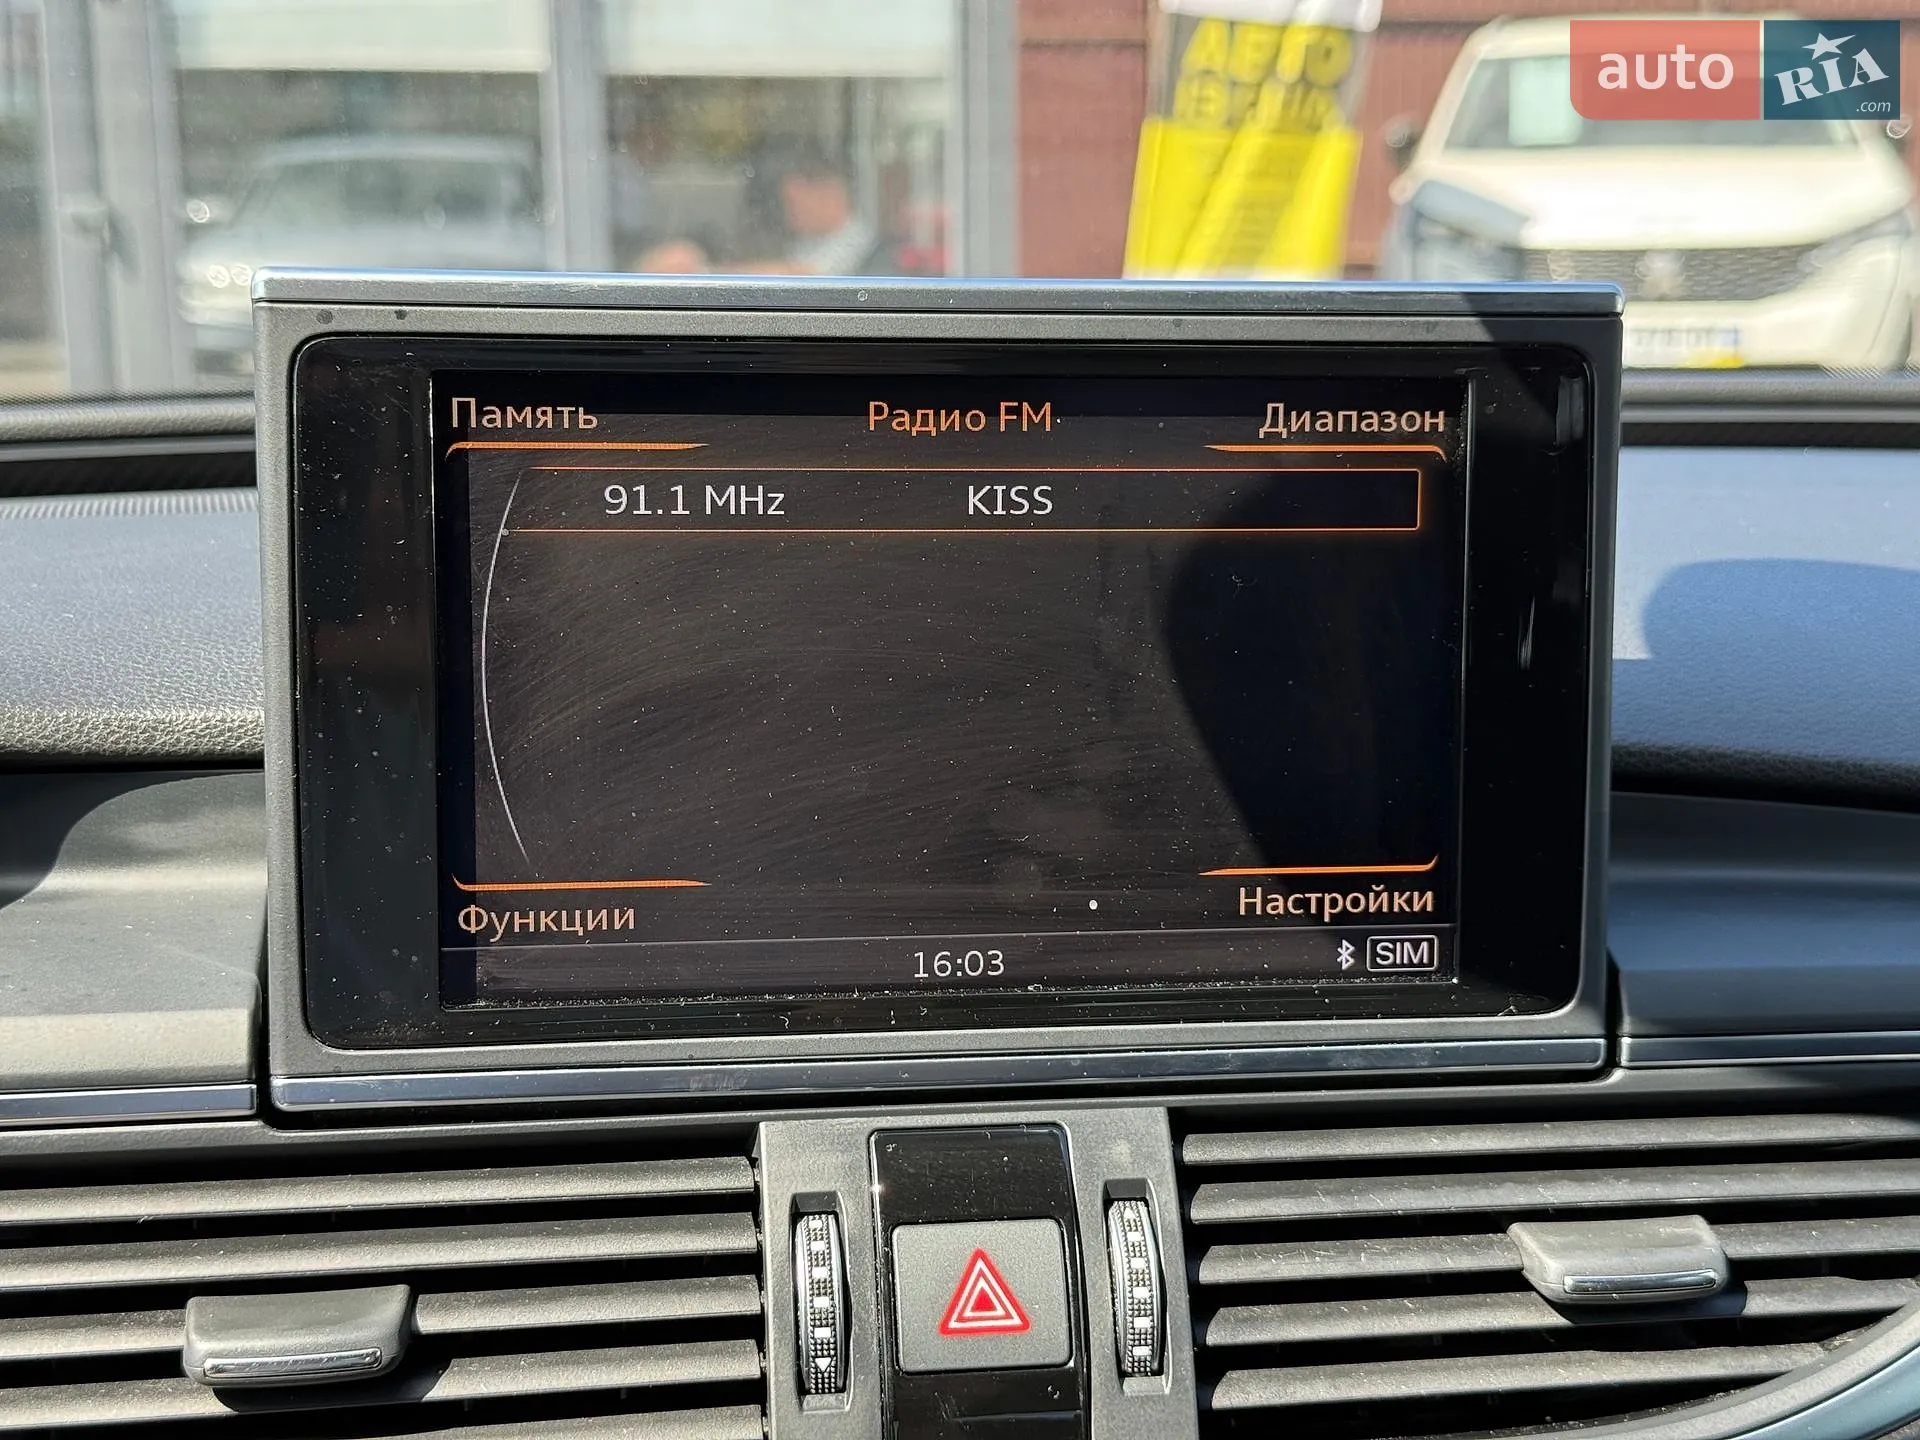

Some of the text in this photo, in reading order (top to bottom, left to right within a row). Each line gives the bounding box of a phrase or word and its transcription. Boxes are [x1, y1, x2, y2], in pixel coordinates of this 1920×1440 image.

[451, 397, 599, 431] Память
[867, 401, 1053, 437] Радио FM
[1258, 402, 1446, 439] Диапазон
[603, 484, 1054, 517] 91.1 MHz KISS
[1238, 884, 1435, 923] Настройки
[457, 901, 637, 942] Функции
[912, 948, 1006, 979] 16:03
[1375, 941, 1430, 966] SIM
